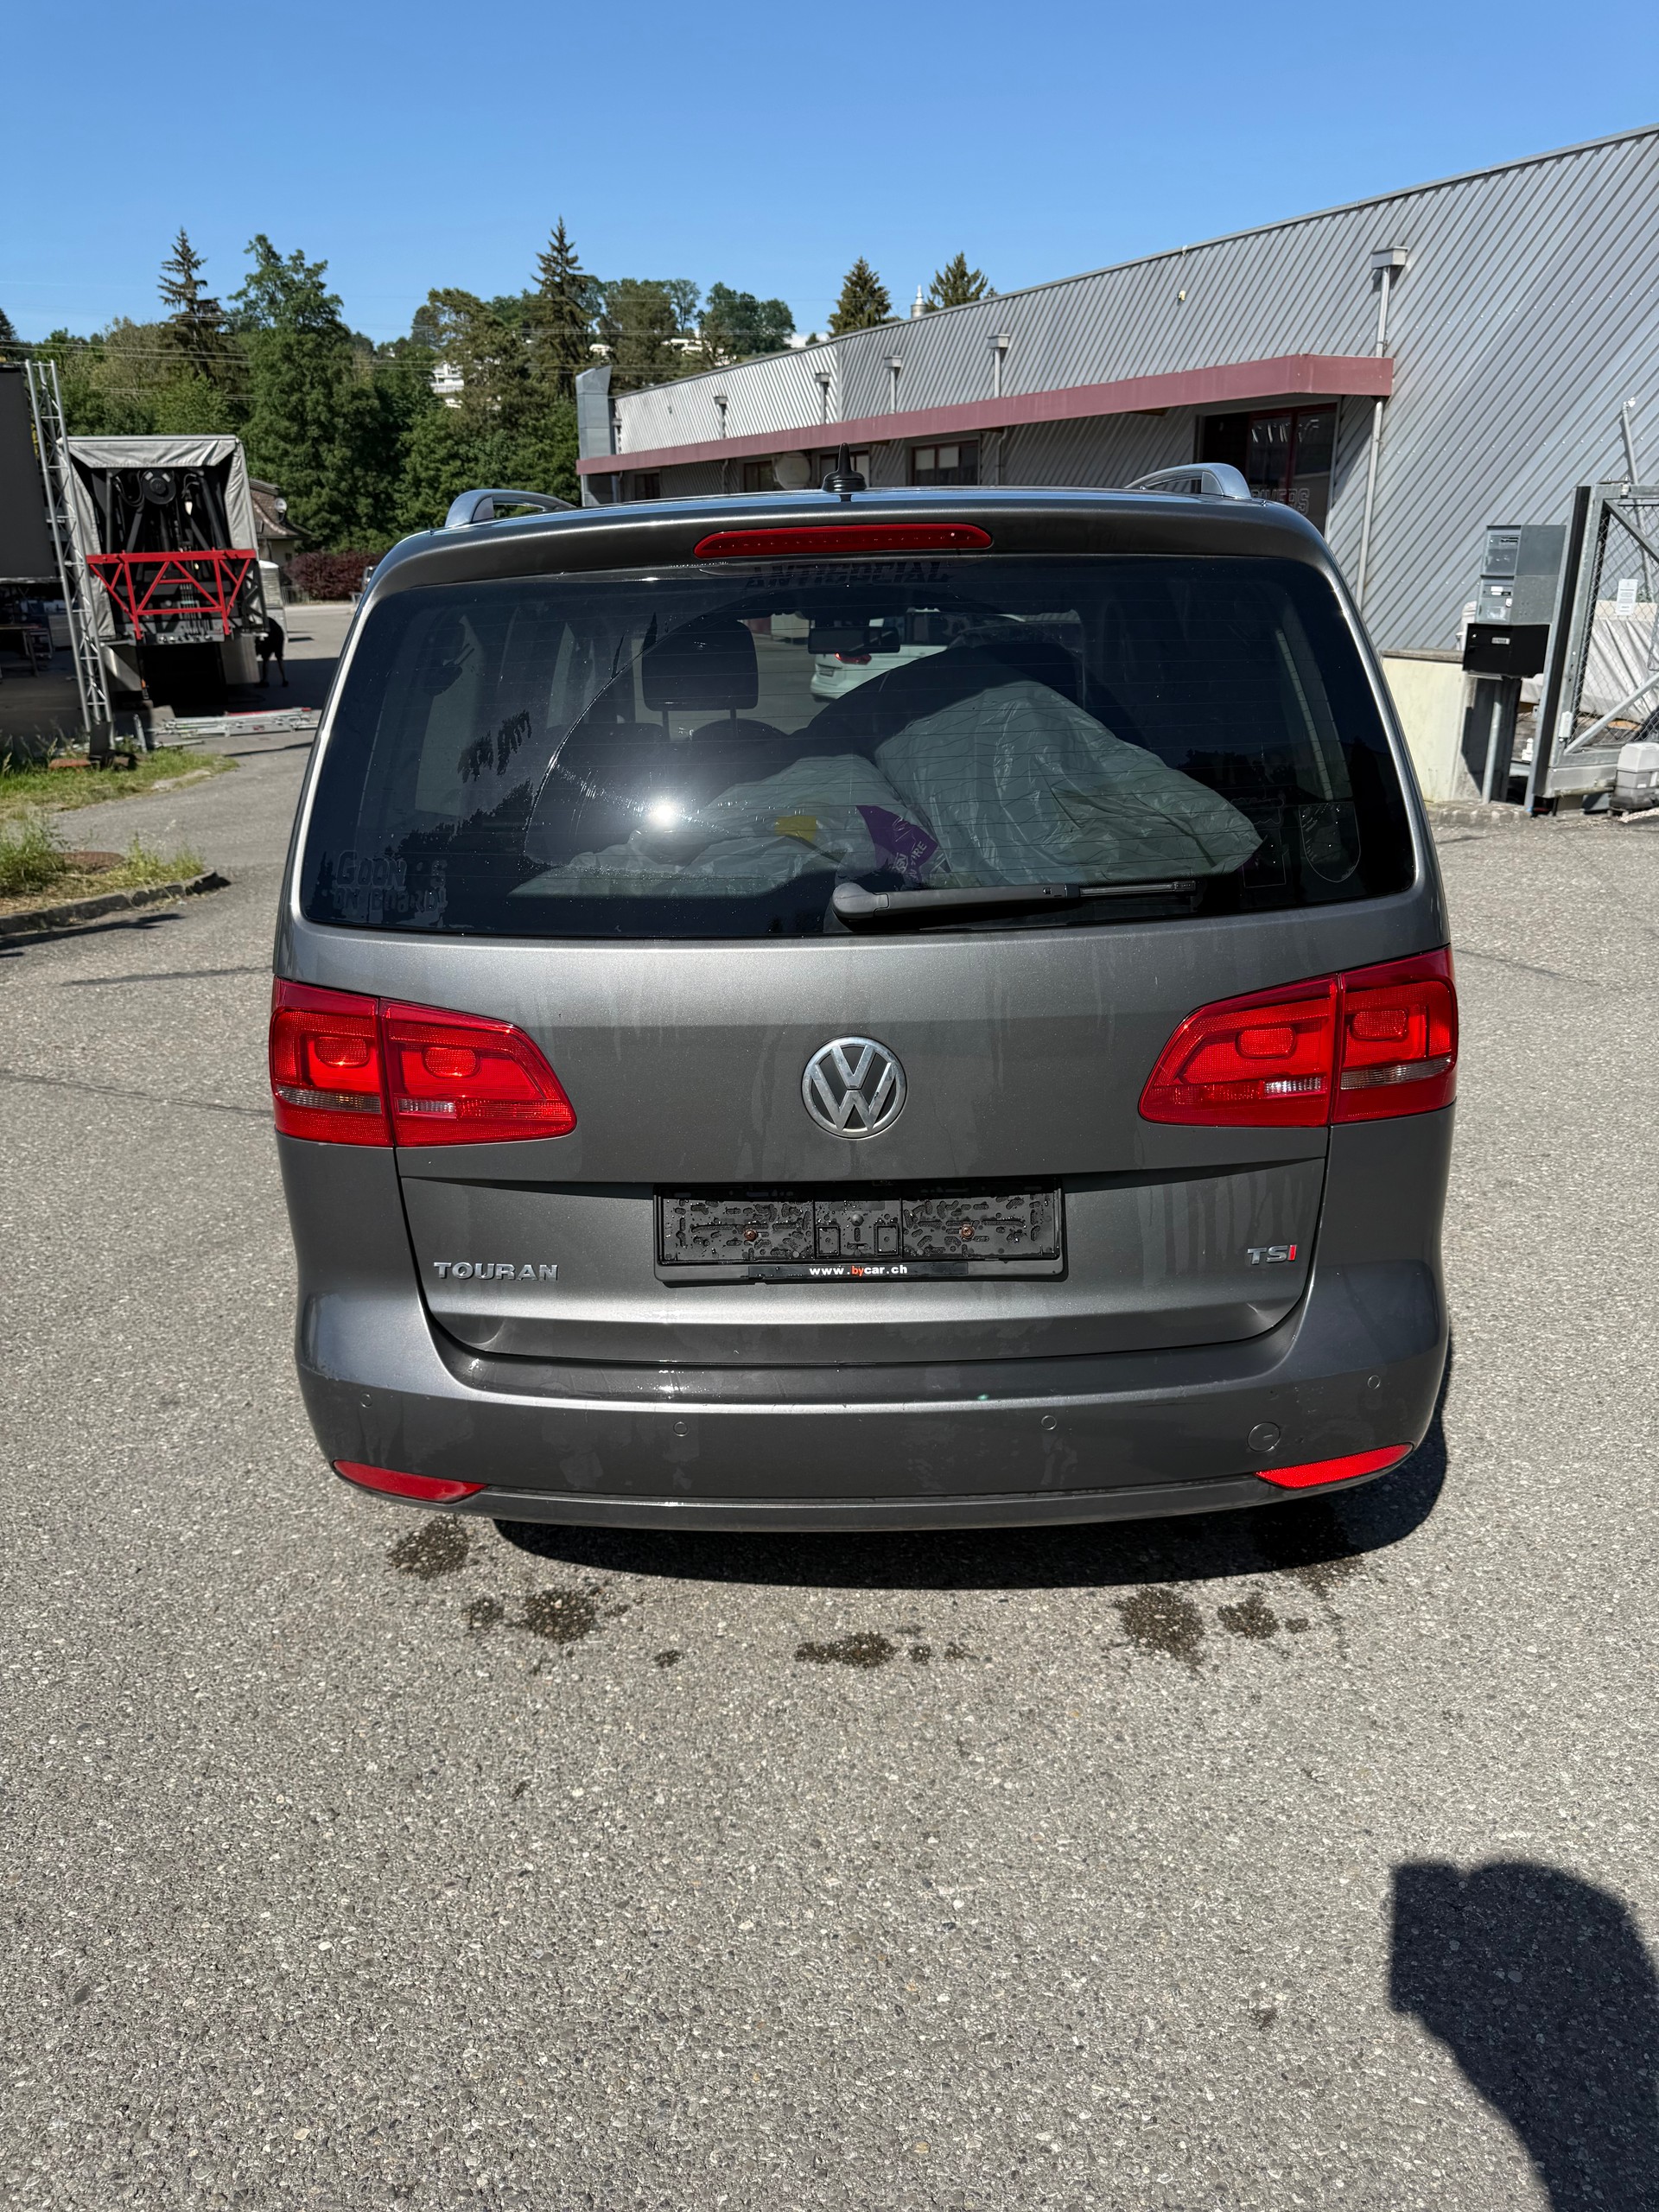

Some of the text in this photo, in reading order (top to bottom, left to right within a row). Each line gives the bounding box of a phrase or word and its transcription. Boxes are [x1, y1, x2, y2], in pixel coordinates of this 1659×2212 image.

[802, 1036, 906, 1140] VW
[1247, 1244, 1297, 1265] TSI
[434, 1262, 558, 1281] TOURAN
[809, 1264, 908, 1276] www.bycar.ch
